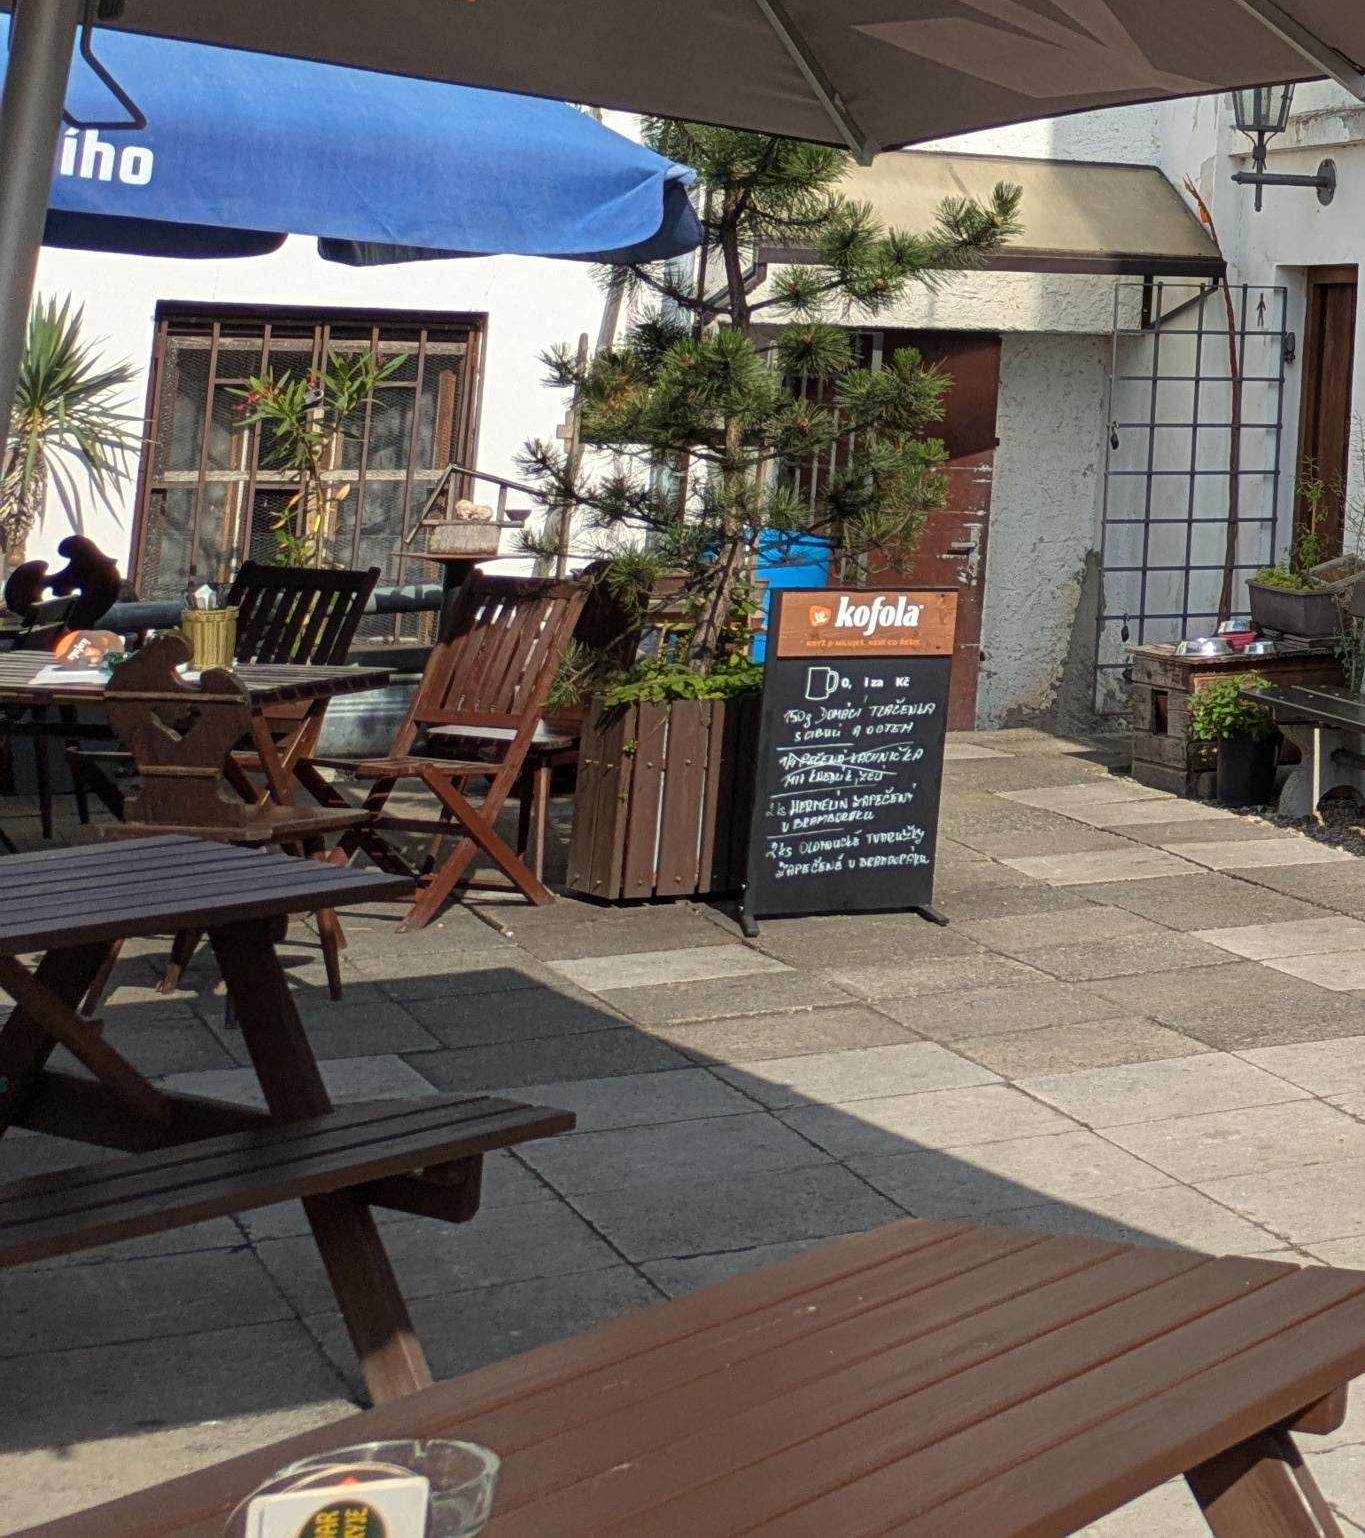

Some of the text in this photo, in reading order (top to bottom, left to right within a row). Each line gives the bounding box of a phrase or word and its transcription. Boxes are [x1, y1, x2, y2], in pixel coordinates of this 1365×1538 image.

[59, 128, 154, 186] ího
[834, 595, 921, 637] kofola
[871, 679, 884, 688] za
[895, 676, 910, 688] Kč
